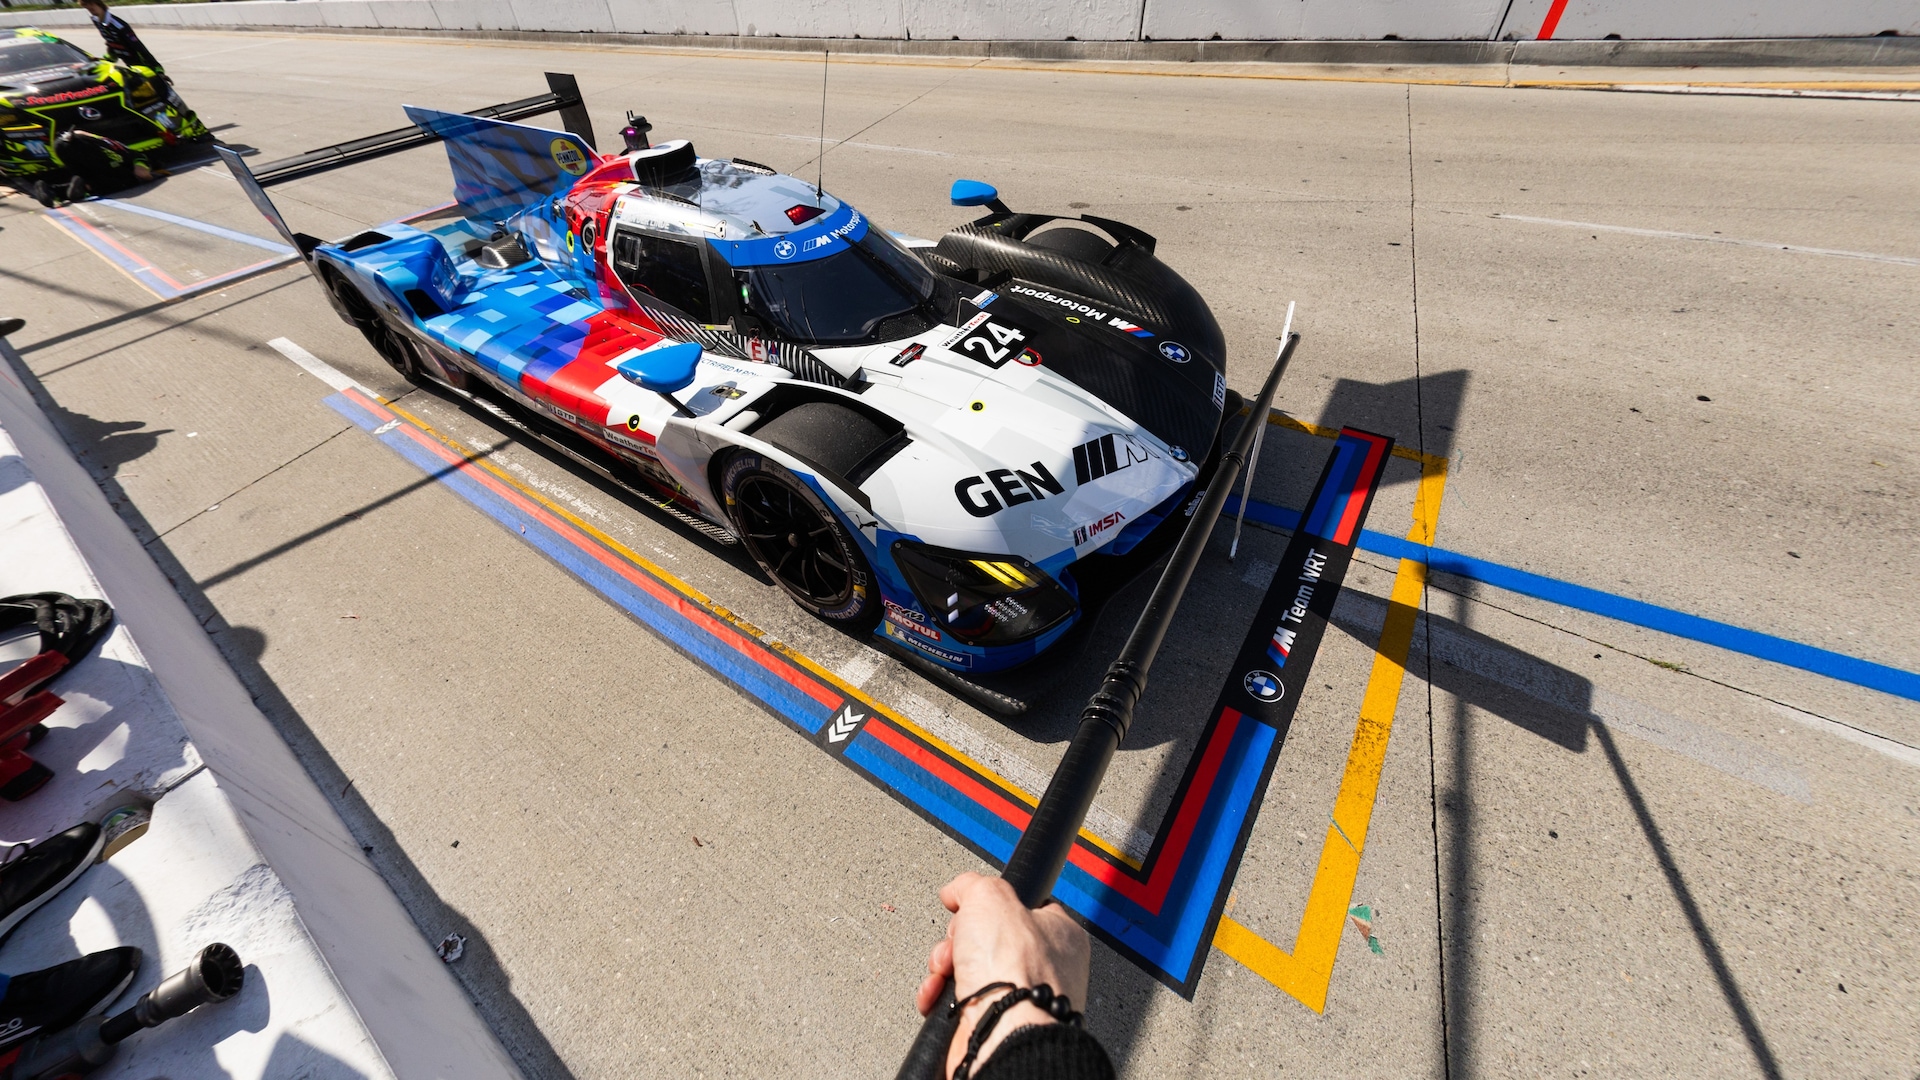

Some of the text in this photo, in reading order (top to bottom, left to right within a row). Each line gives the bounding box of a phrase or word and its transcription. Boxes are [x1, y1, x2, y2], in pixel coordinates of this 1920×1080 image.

[556, 150, 581, 164] PENNZOIL
[1010, 285, 1107, 321] Motorsport
[942, 313, 987, 347] WeatherTech
[963, 321, 1026, 364] 24
[701, 357, 735, 373] CTRIFIED
[751, 342, 764, 362] E
[603, 429, 658, 457] WeatherTe
[726, 457, 757, 487] MICHELIN
[782, 472, 805, 491] SPORT
[954, 460, 1066, 519] GEN
[1088, 511, 1126, 538] IMSA
[1281, 585, 1315, 624] Team
[1298, 548, 1328, 584] WRT
[889, 610, 939, 641] MOTUL
[907, 637, 964, 663] MICHELIN
